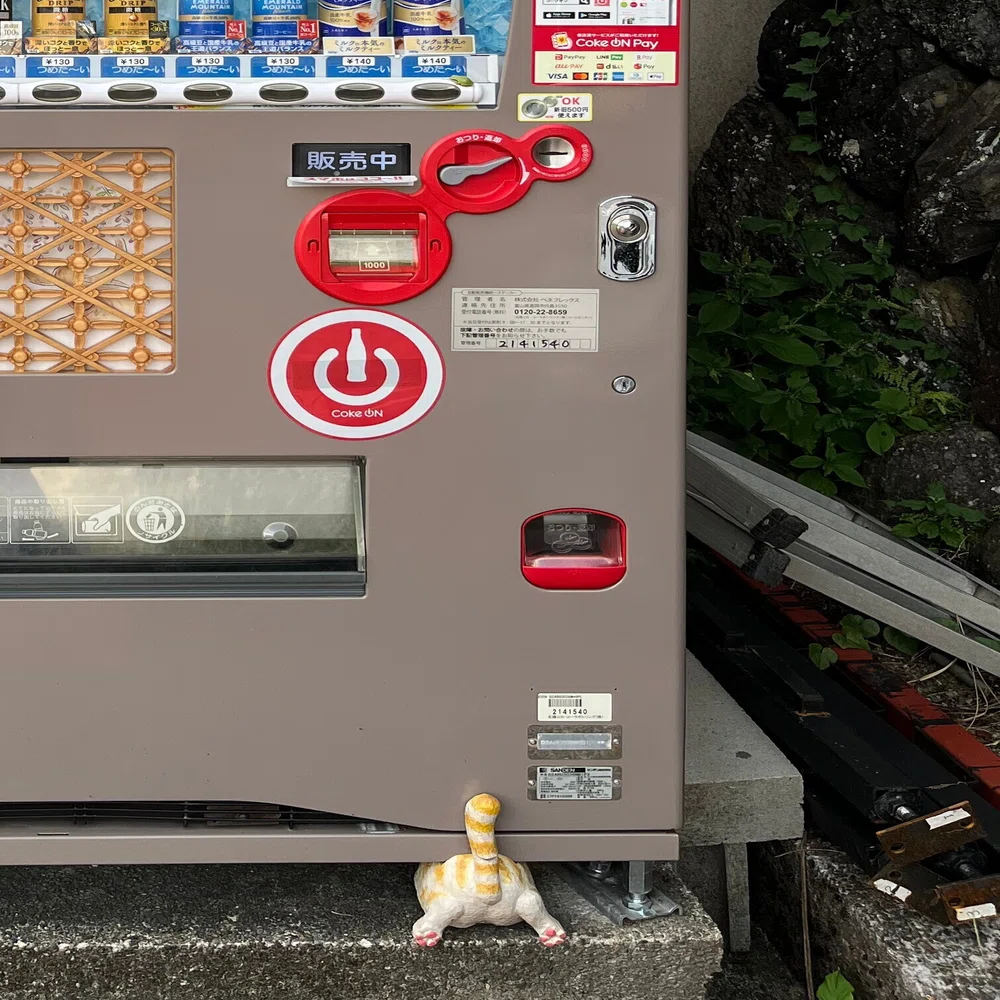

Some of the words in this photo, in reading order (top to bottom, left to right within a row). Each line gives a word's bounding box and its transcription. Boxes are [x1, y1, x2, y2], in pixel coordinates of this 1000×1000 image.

[575, 38, 609, 47] Coke
[610, 37, 630, 47] ON
[633, 39, 659, 50] Pay
[562, 97, 580, 105] OK
[307, 150, 397, 171] 販売中
[499, 340, 570, 348] 2141540
[331, 409, 362, 418] Coke
[364, 408, 383, 418] ON
